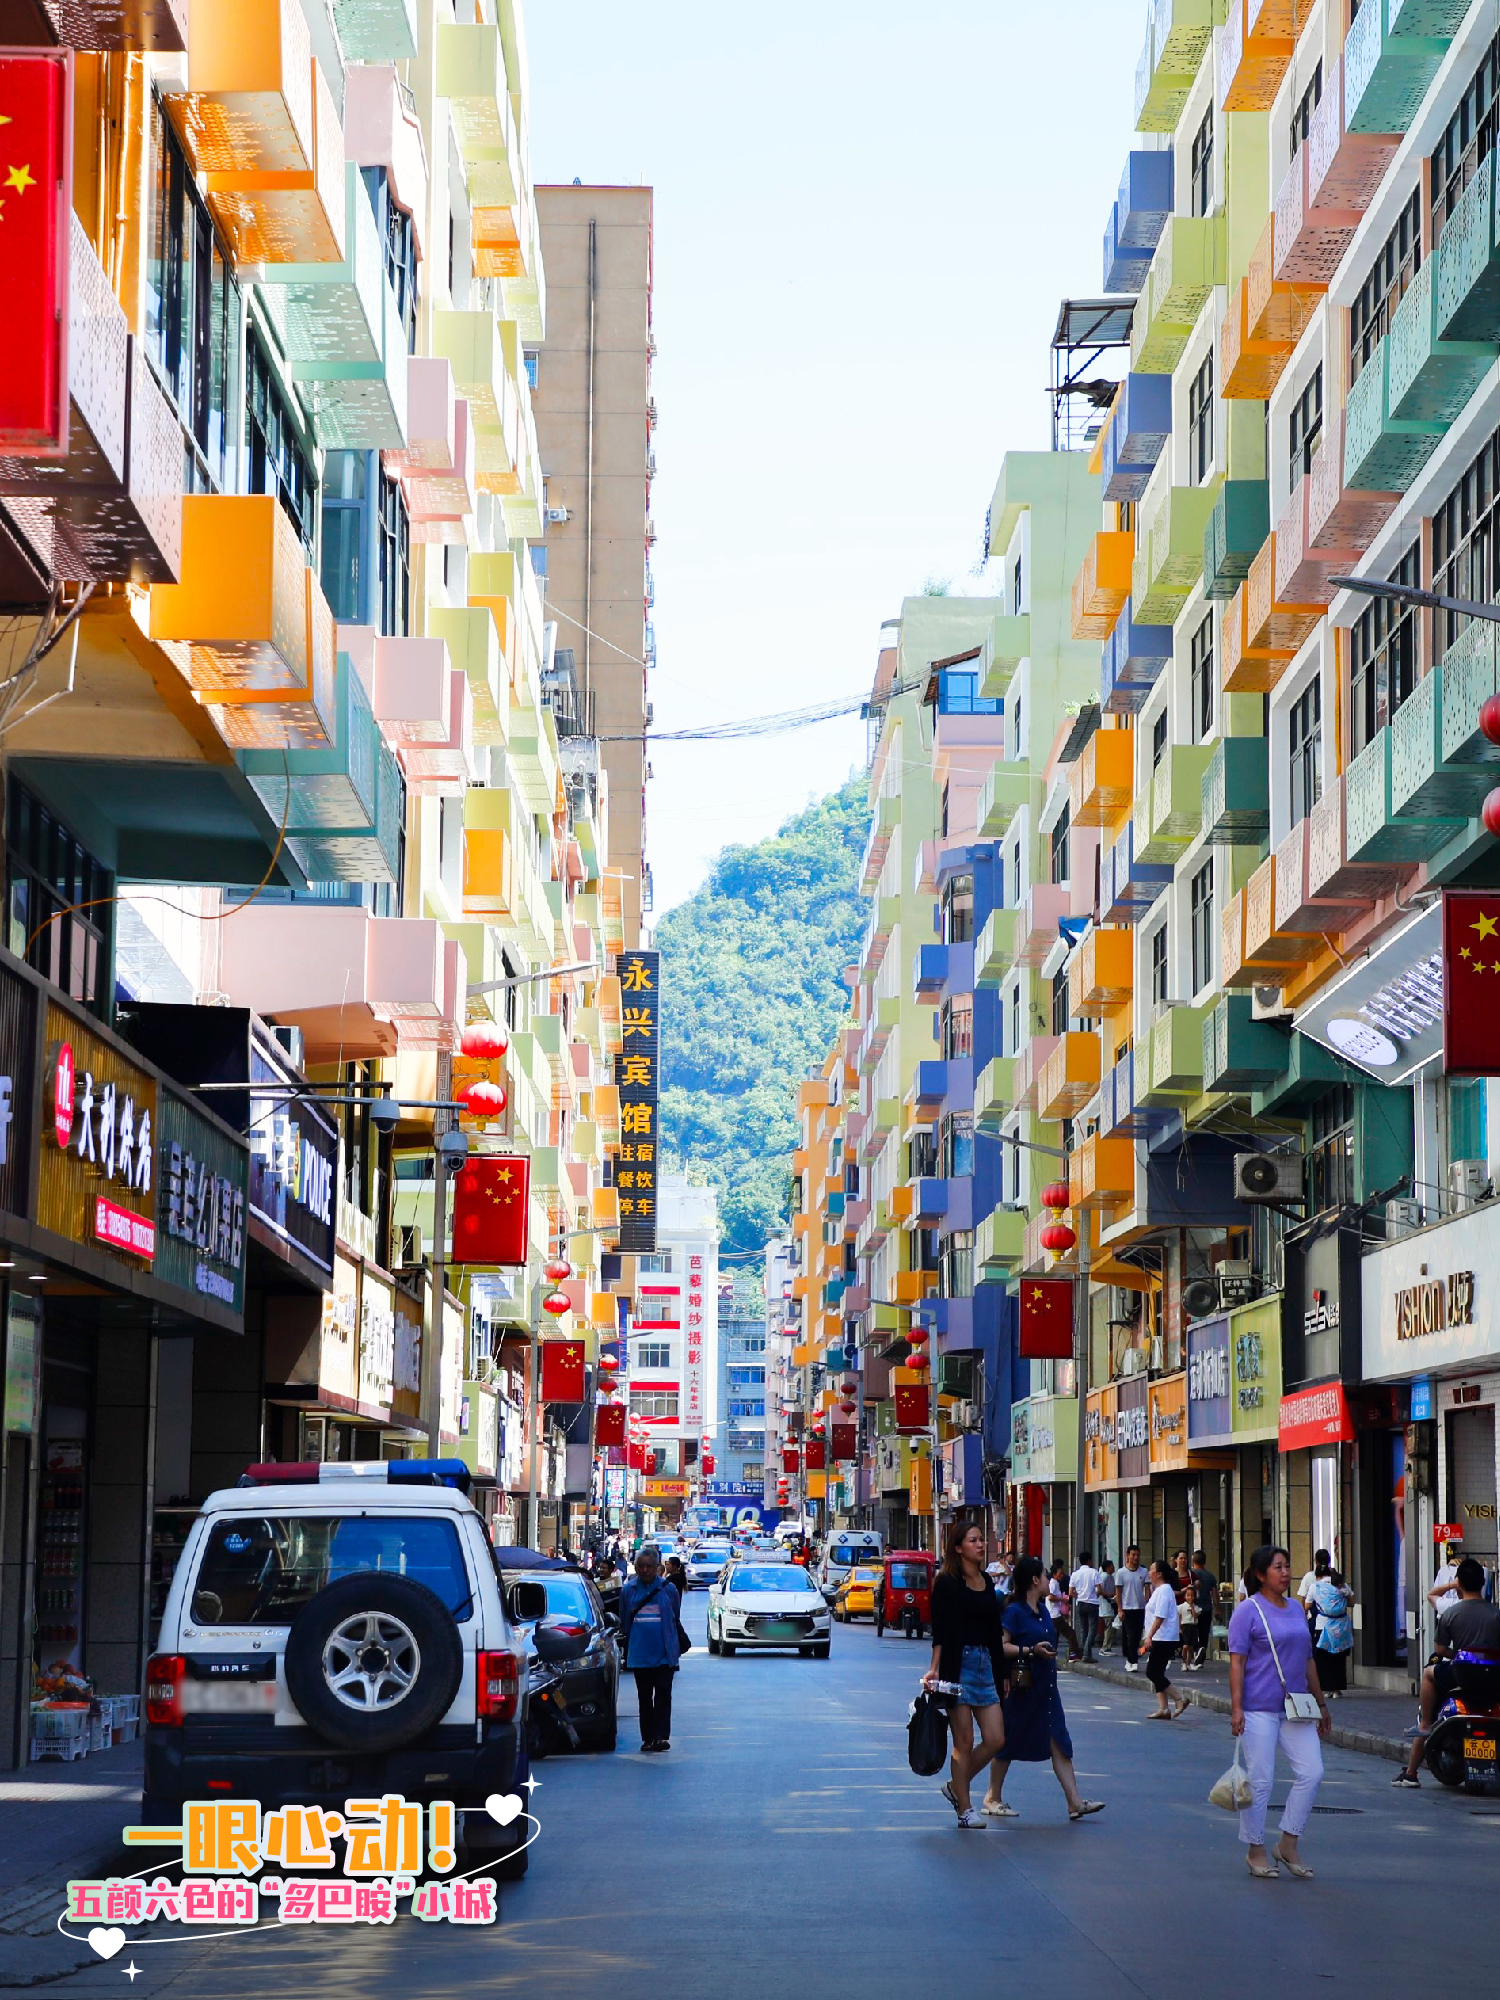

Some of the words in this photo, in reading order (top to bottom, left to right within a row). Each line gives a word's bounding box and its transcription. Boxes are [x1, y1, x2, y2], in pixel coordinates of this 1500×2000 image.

[621, 959, 654, 1135] 永兴宾馆
[619, 1143, 654, 1162] 住宿
[302, 1137, 333, 1226] POLICE
[617, 1170, 654, 1189] 餐饮
[617, 1198, 654, 1216] 停车
[1434, 1525, 1451, 1538] 79
